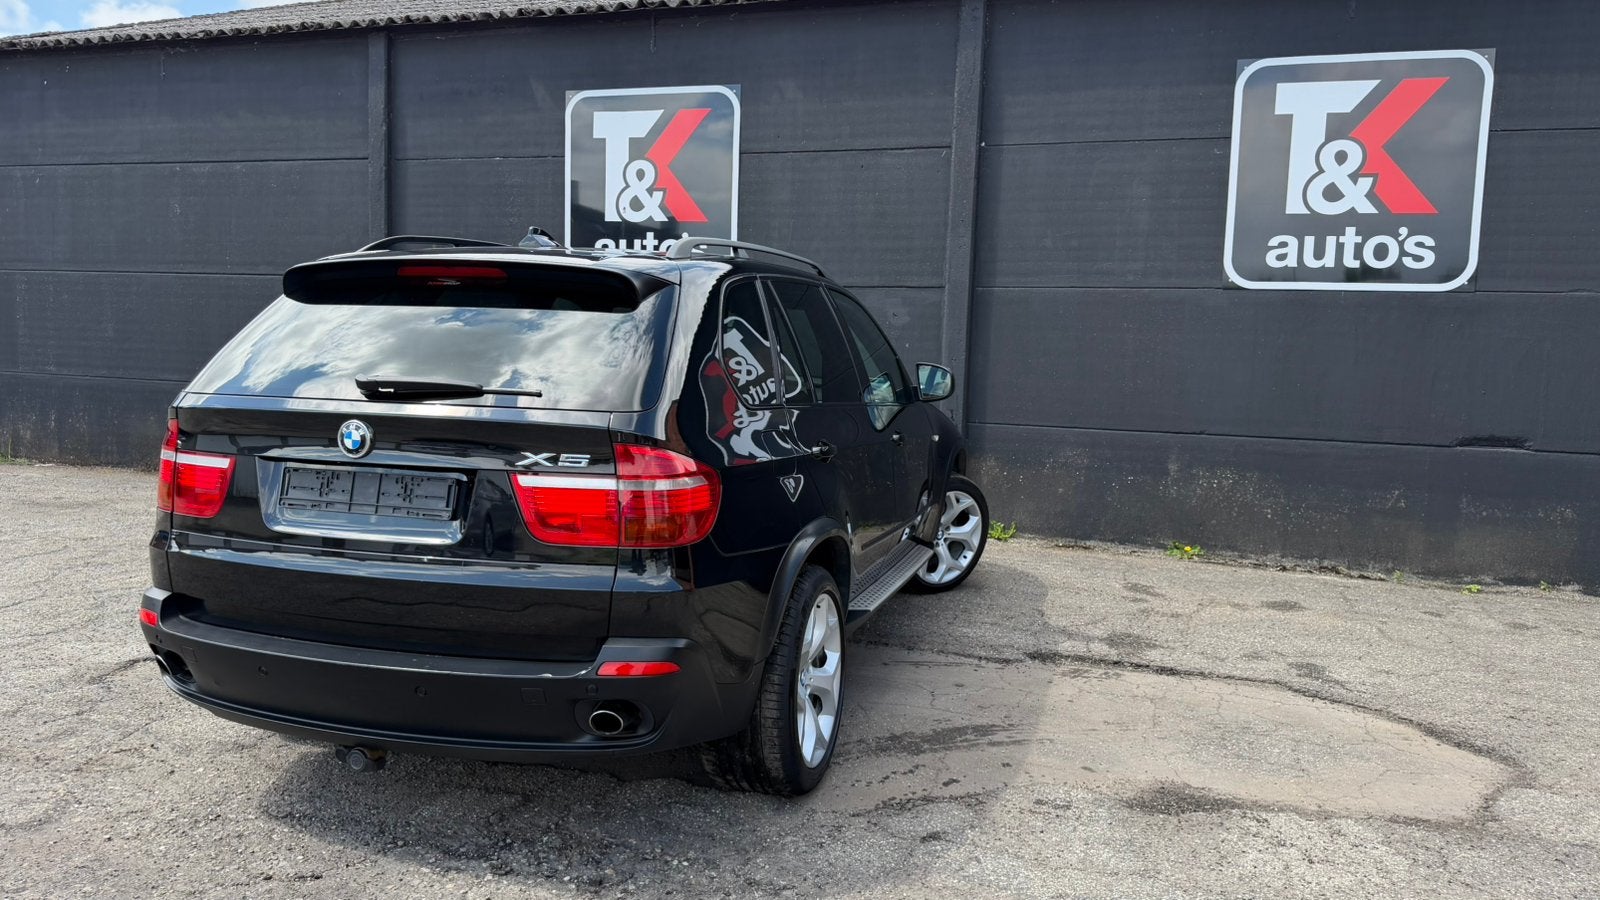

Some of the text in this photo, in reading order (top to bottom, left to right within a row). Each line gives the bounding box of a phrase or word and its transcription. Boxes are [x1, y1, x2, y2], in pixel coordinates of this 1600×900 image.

[592, 108, 713, 223] T&K
[1274, 76, 1451, 216] T&K
[1265, 226, 1436, 270] auto's
[514, 451, 592, 468] X5
